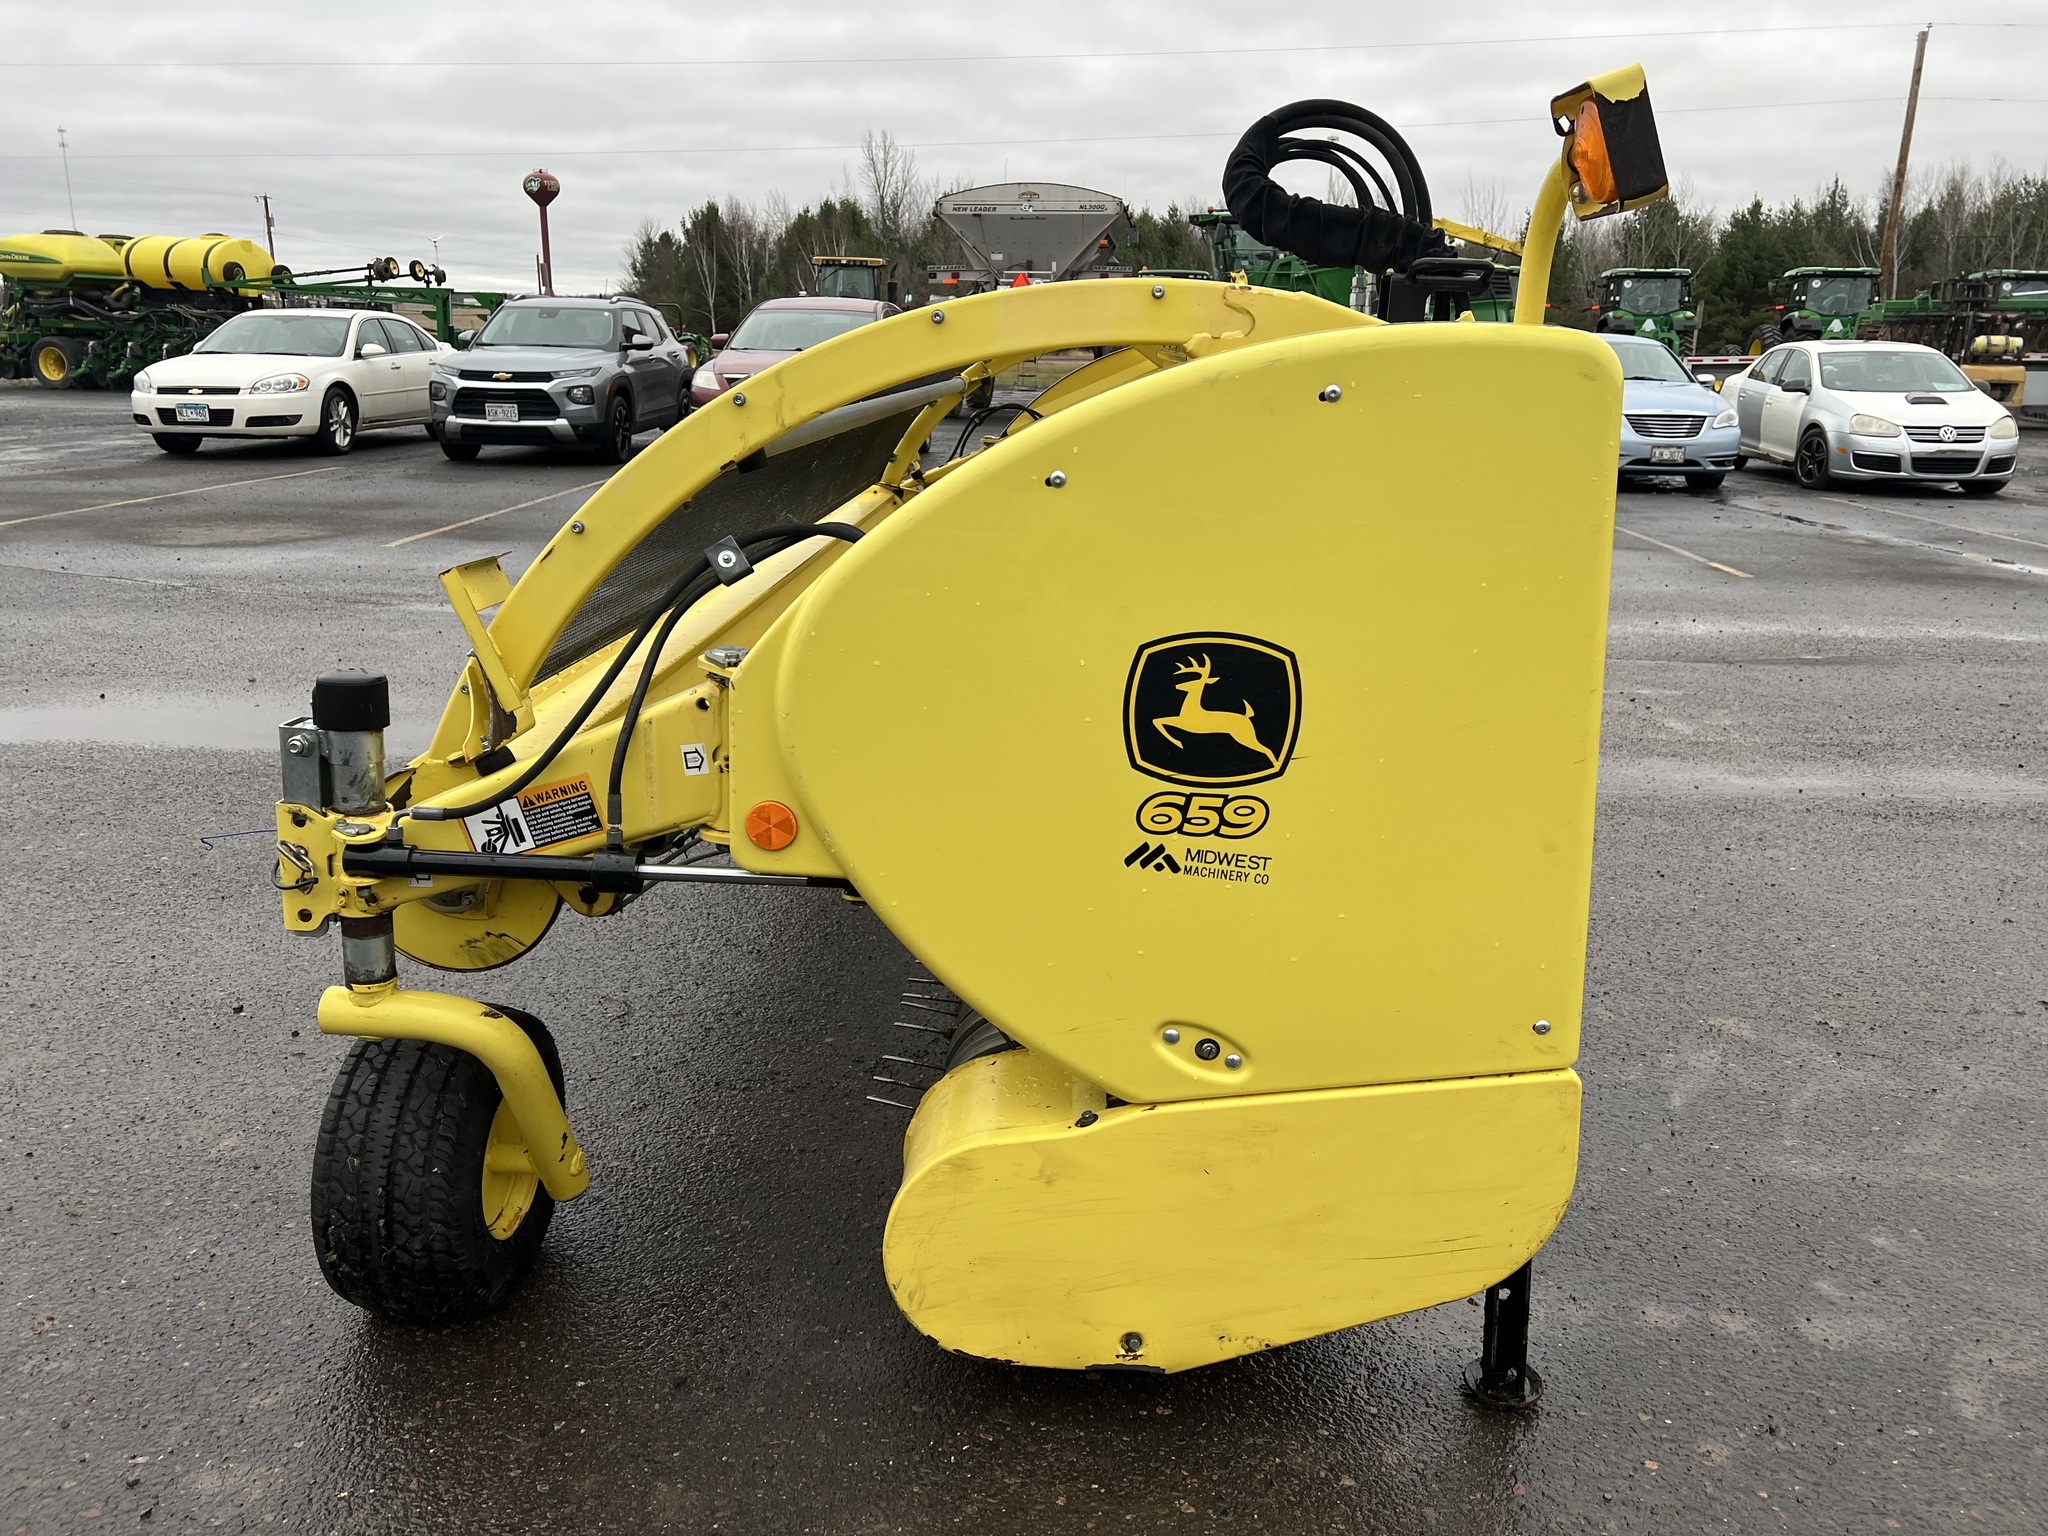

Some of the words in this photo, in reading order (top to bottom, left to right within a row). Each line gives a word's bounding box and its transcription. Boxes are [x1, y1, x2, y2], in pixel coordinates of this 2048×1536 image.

[534, 781, 587, 804] WARNING
[1136, 791, 1270, 839] 659
[1185, 848, 1272, 871] MIDWEST
[1183, 864, 1250, 883] MACHINERY
[1253, 873, 1270, 885] CO
